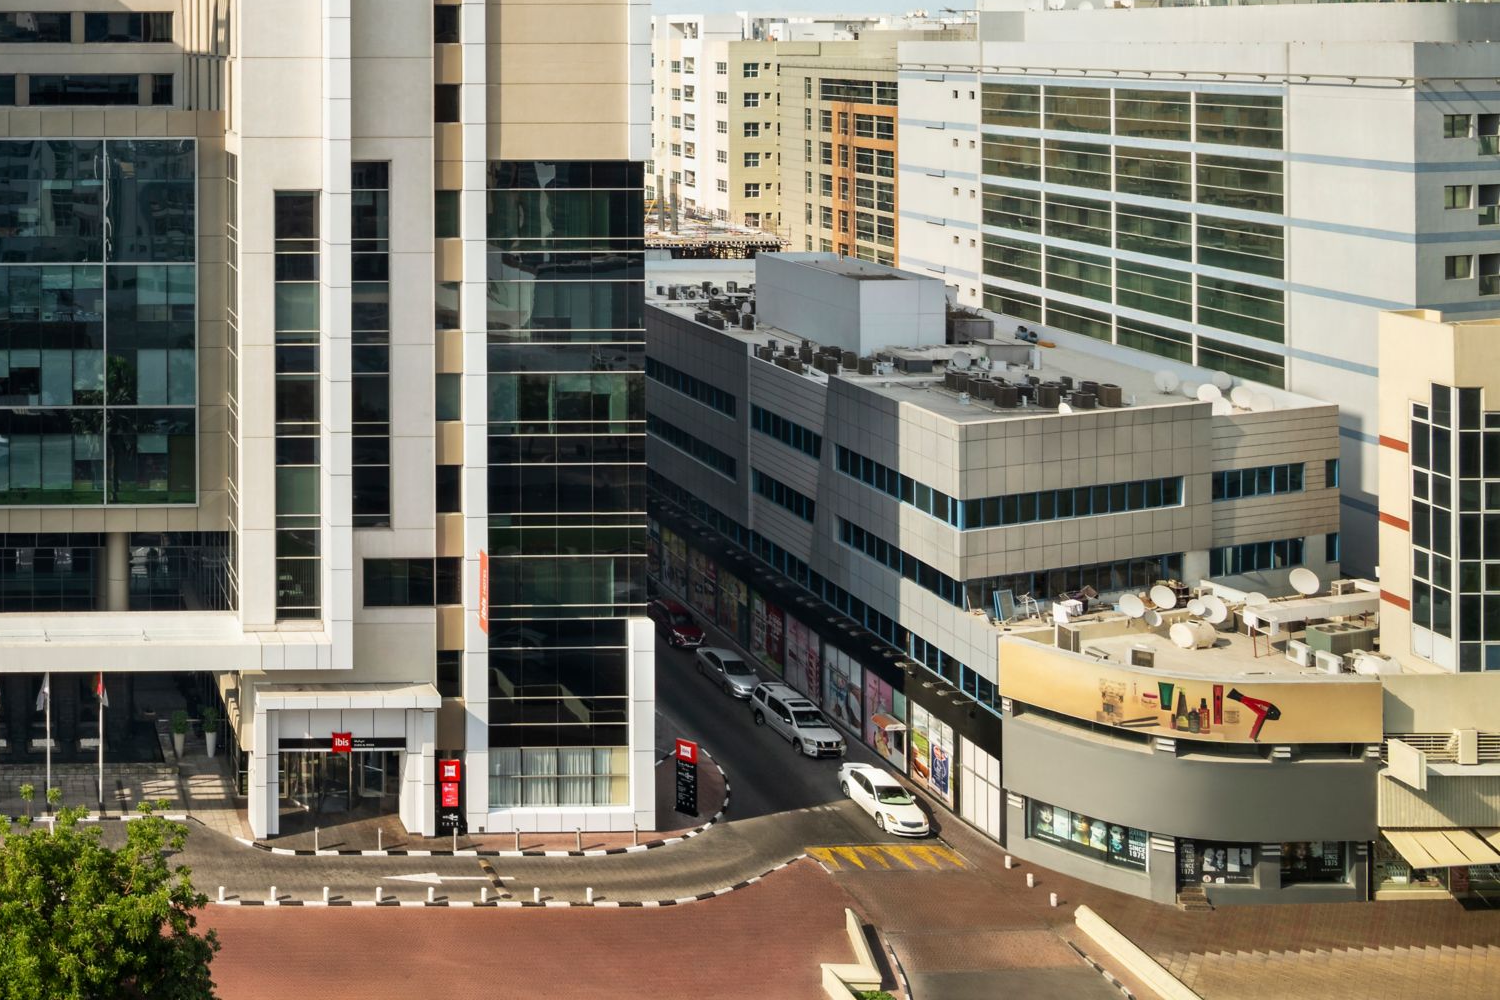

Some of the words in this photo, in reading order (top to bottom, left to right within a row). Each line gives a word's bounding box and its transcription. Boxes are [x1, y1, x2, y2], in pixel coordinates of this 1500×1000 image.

[335, 737, 349, 746] ibis
[1129, 844, 1145, 853] SINCE
[1129, 850, 1145, 860] 1975
